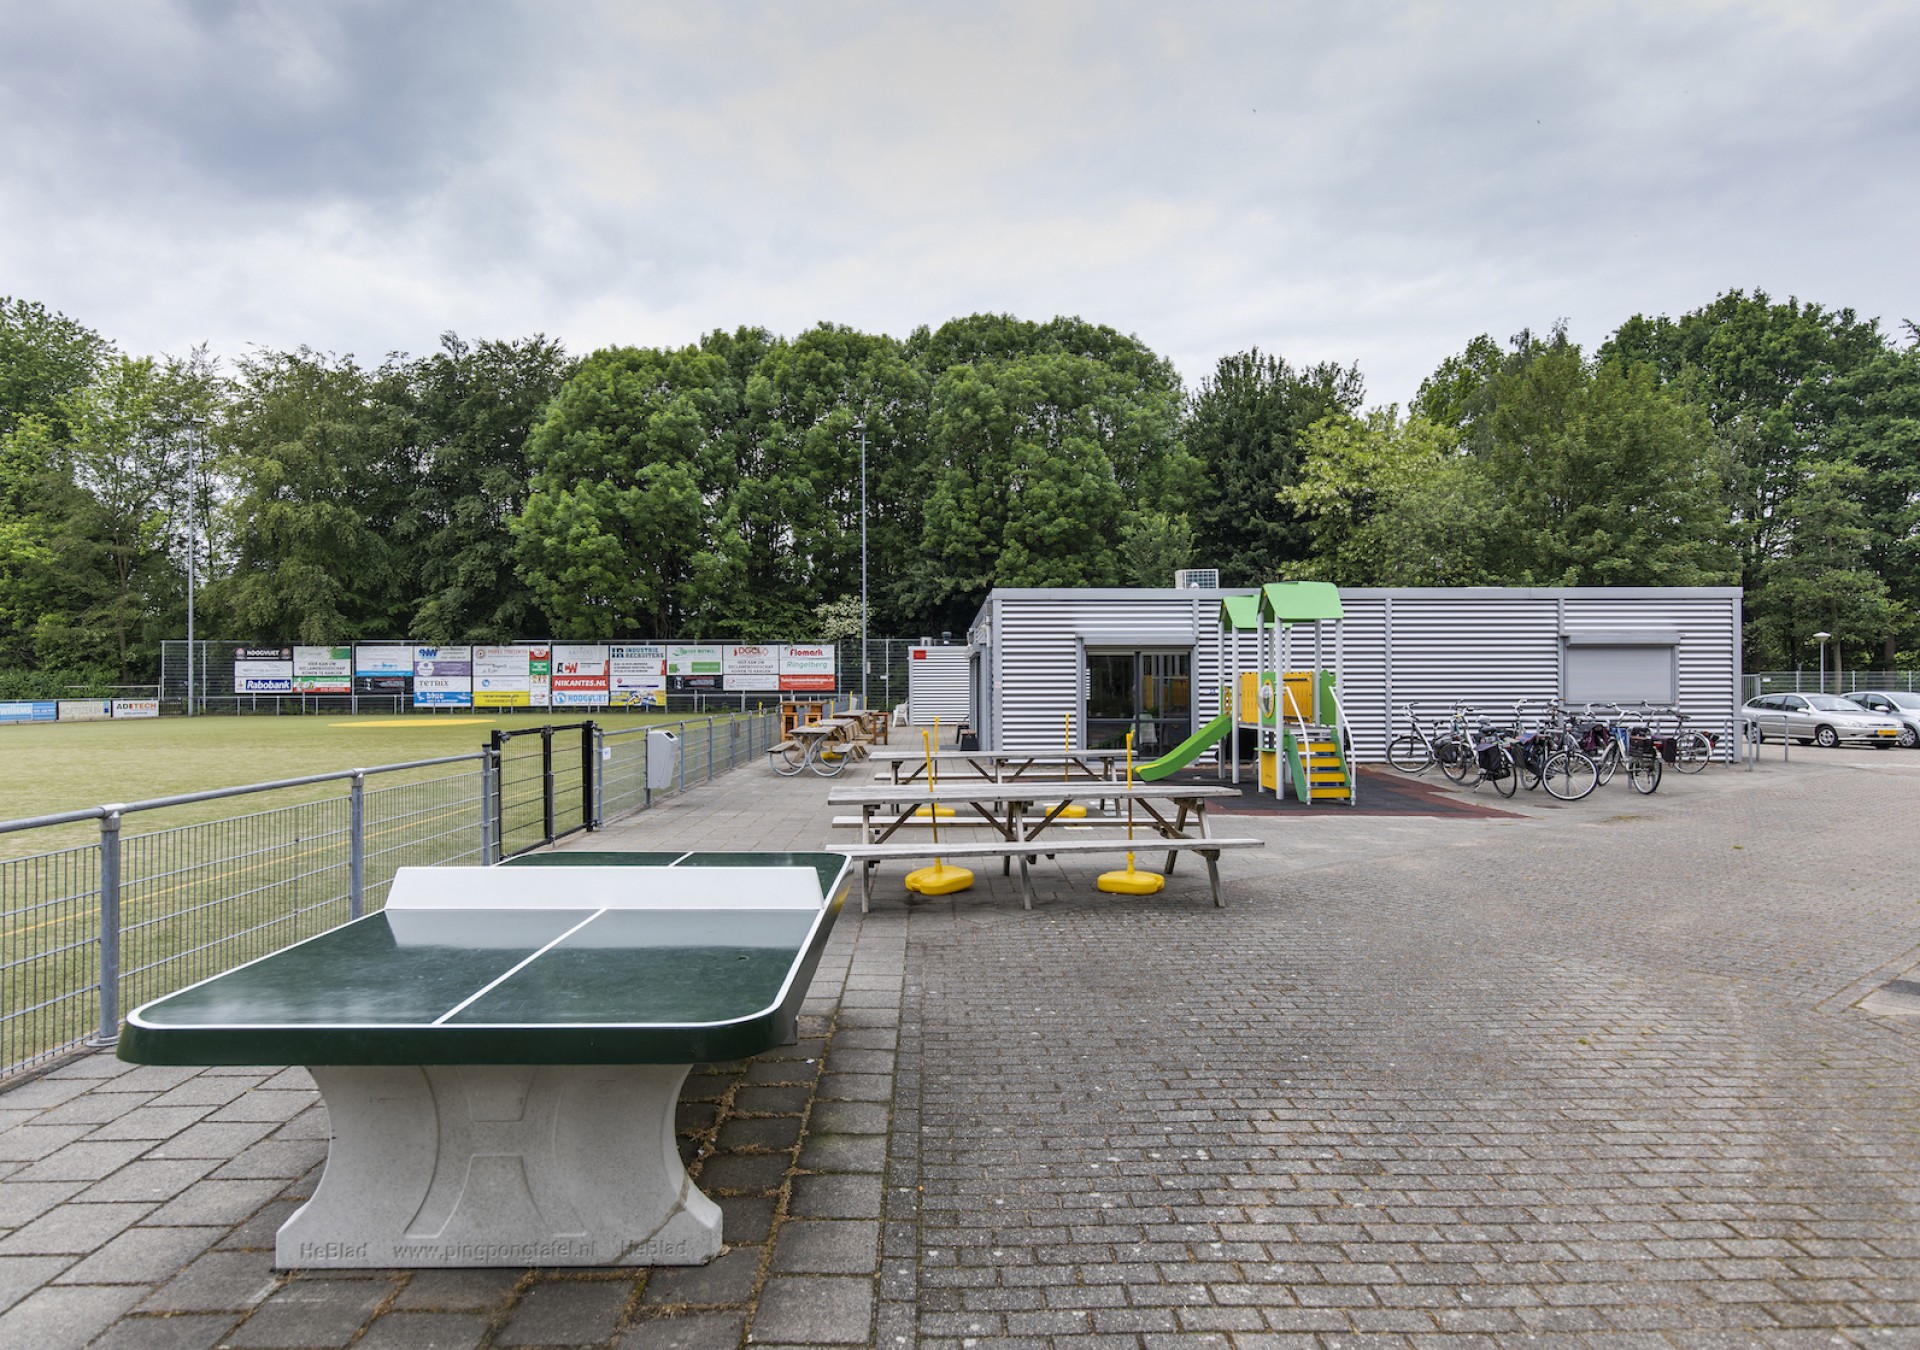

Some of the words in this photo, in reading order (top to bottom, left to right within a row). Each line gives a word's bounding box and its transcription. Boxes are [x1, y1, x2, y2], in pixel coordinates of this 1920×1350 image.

[786, 661, 828, 669] Ringelberg
[247, 680, 290, 689] Rabobank
[554, 679, 607, 687] NIKANTES.NL
[300, 1242, 368, 1260] HeBlad
[393, 1240, 596, 1263] www.pingpongtafel.nl
